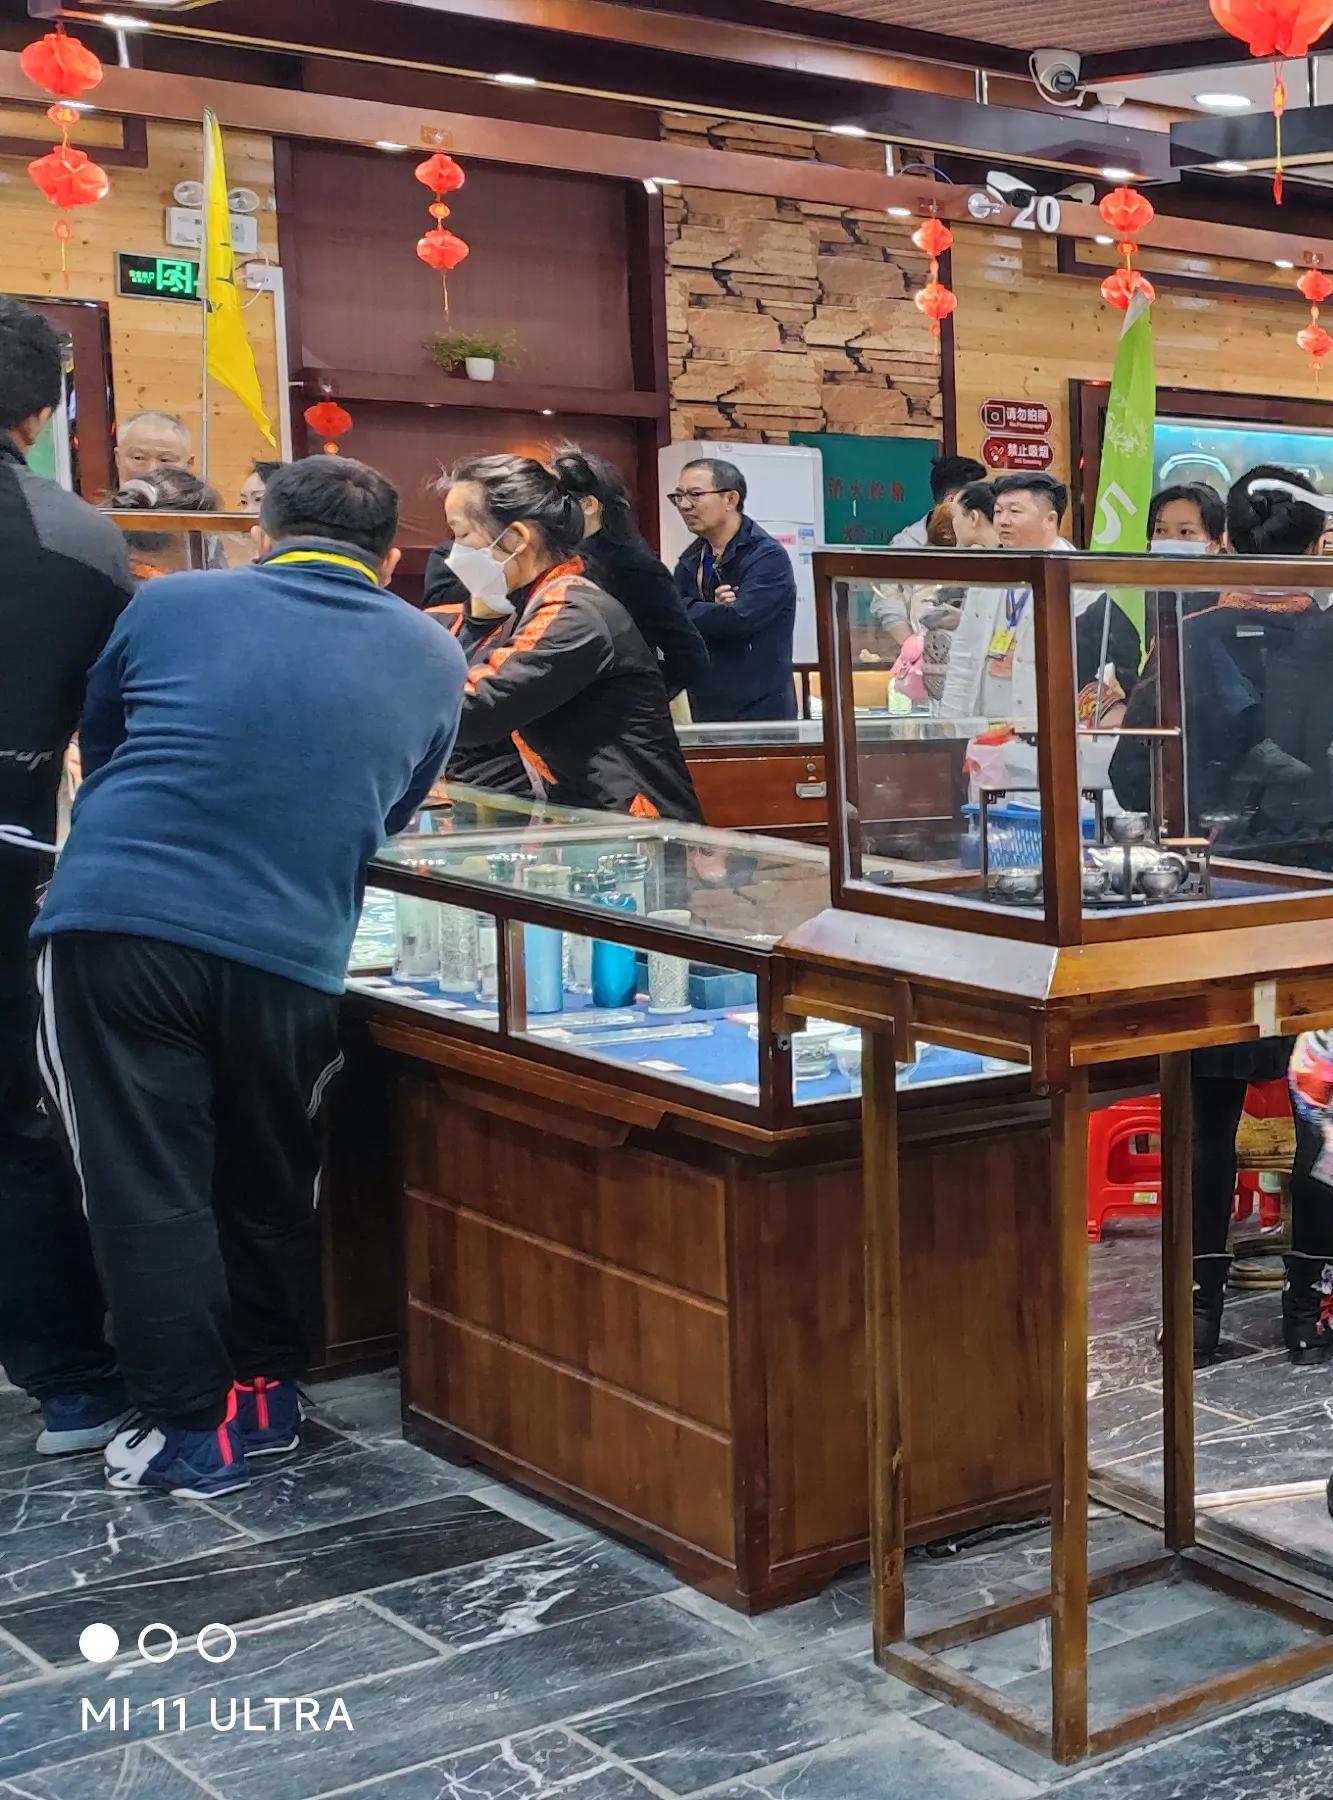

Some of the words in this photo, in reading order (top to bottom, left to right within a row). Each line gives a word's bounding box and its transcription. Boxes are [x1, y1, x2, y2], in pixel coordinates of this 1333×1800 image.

[1011, 196, 1060, 233] 20
[1006, 407, 1048, 423] 请勿拍照
[1007, 442, 1050, 459] 禁止吸烟
